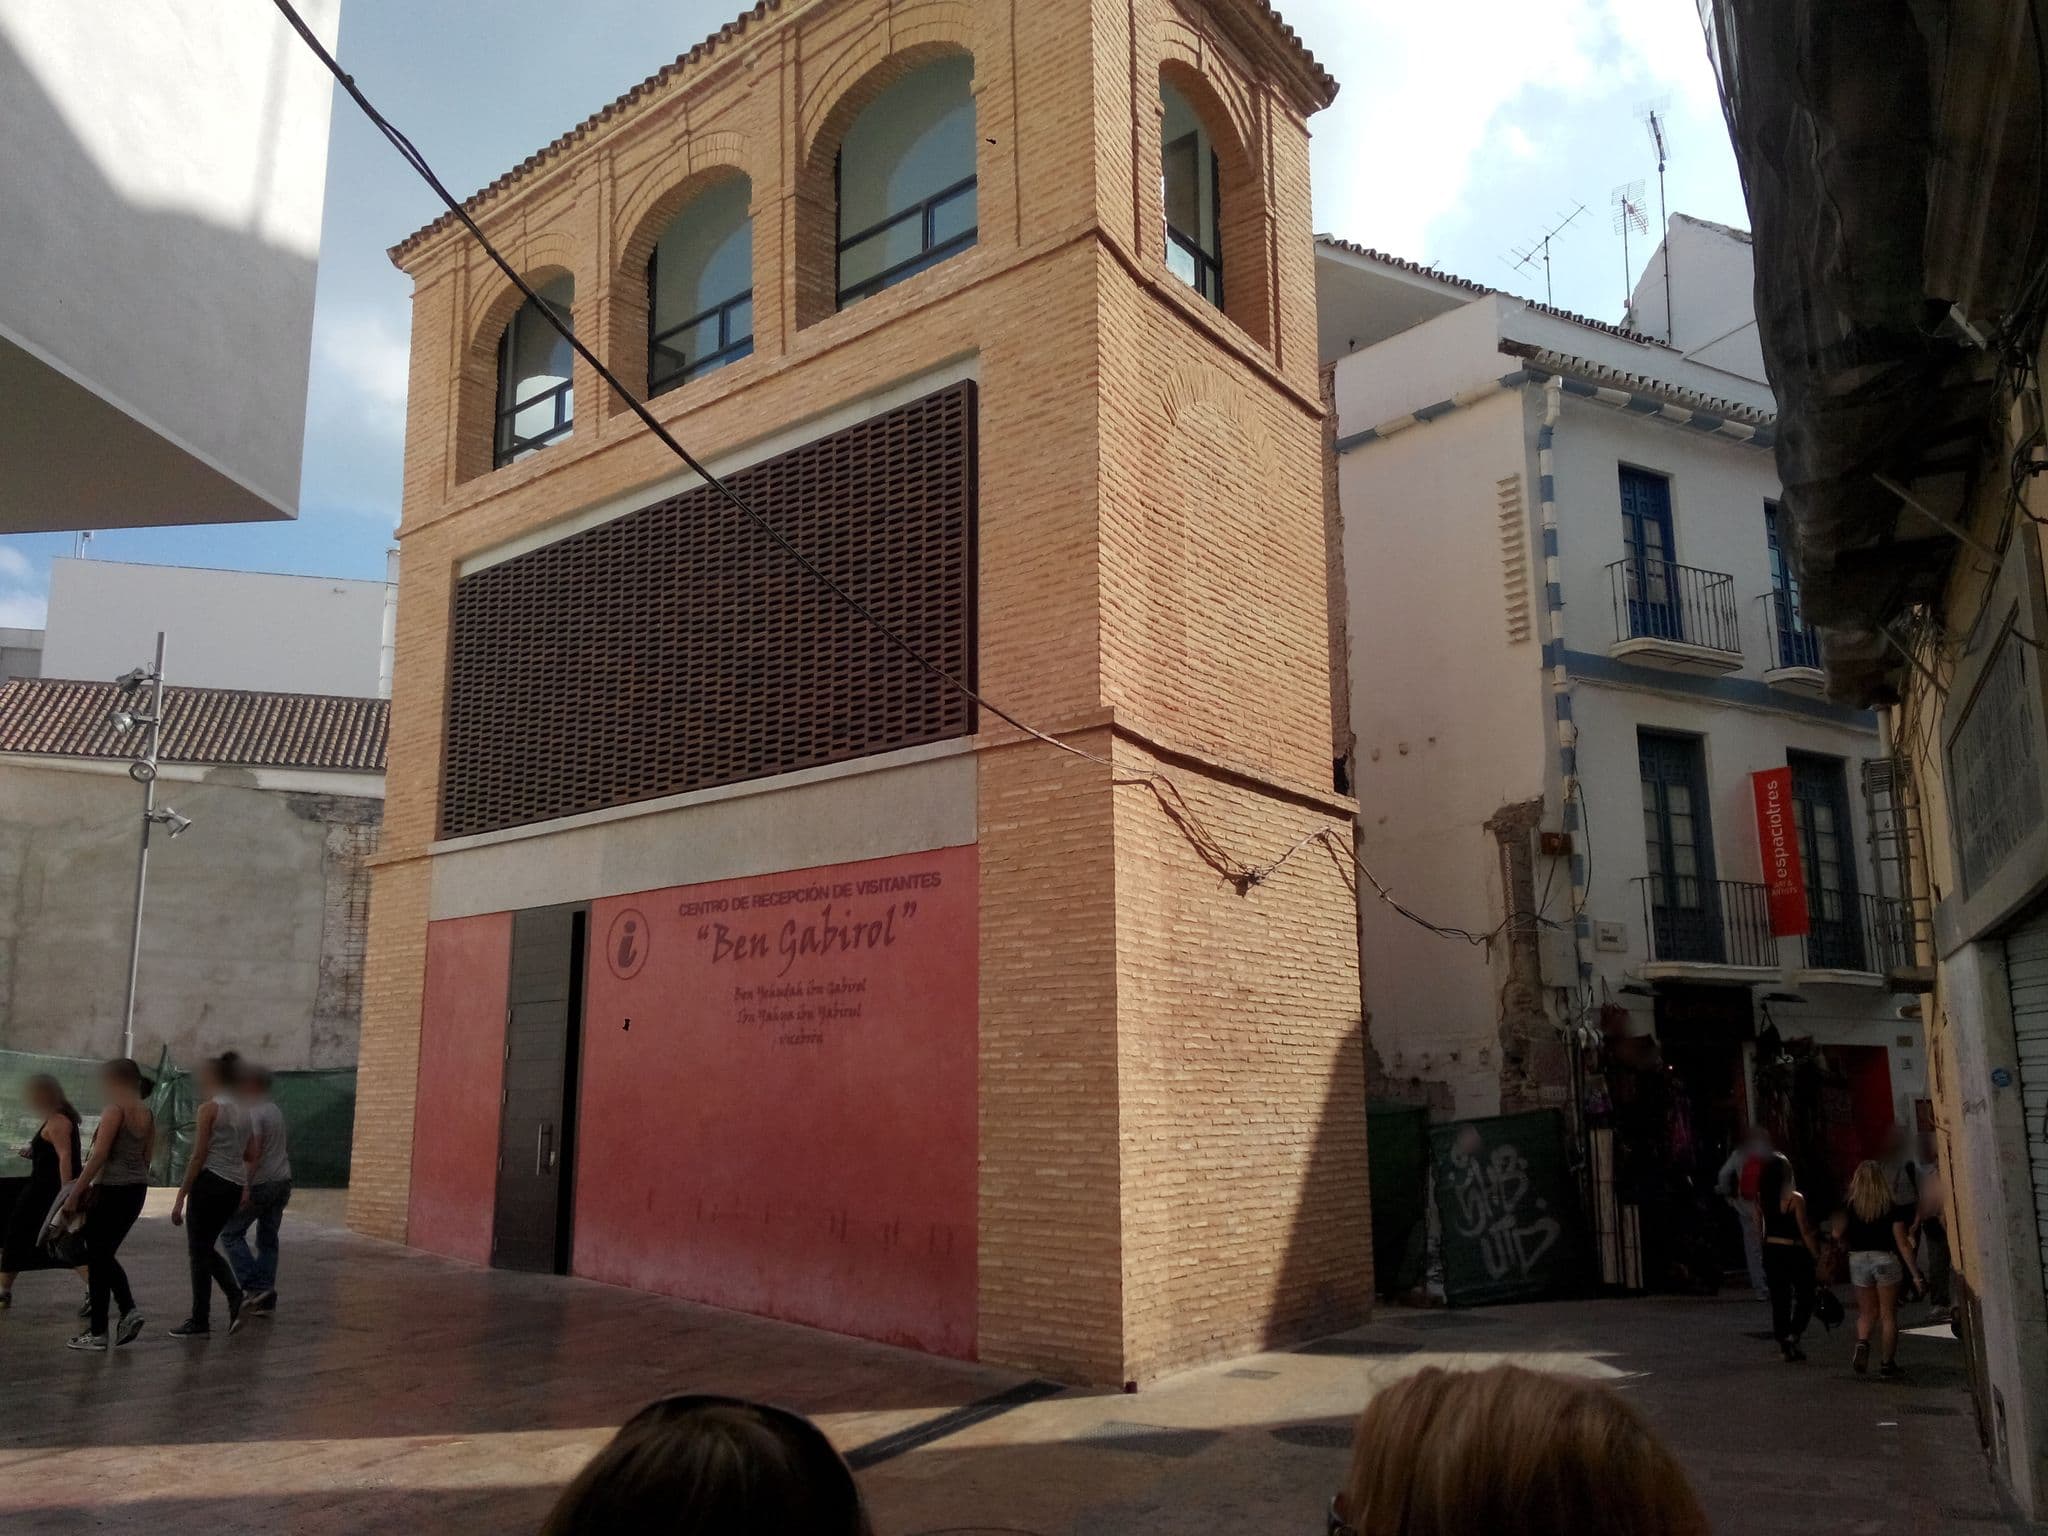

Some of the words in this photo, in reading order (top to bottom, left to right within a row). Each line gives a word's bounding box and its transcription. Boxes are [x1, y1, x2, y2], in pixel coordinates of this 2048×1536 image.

[1766, 780, 1790, 879] espaciotres
[679, 897, 730, 917] CENTRO
[731, 895, 750, 912] DE
[751, 882, 830, 909] RECEPCIÓN
[832, 882, 853, 898] DE
[855, 871, 942, 896] VISITANTES
